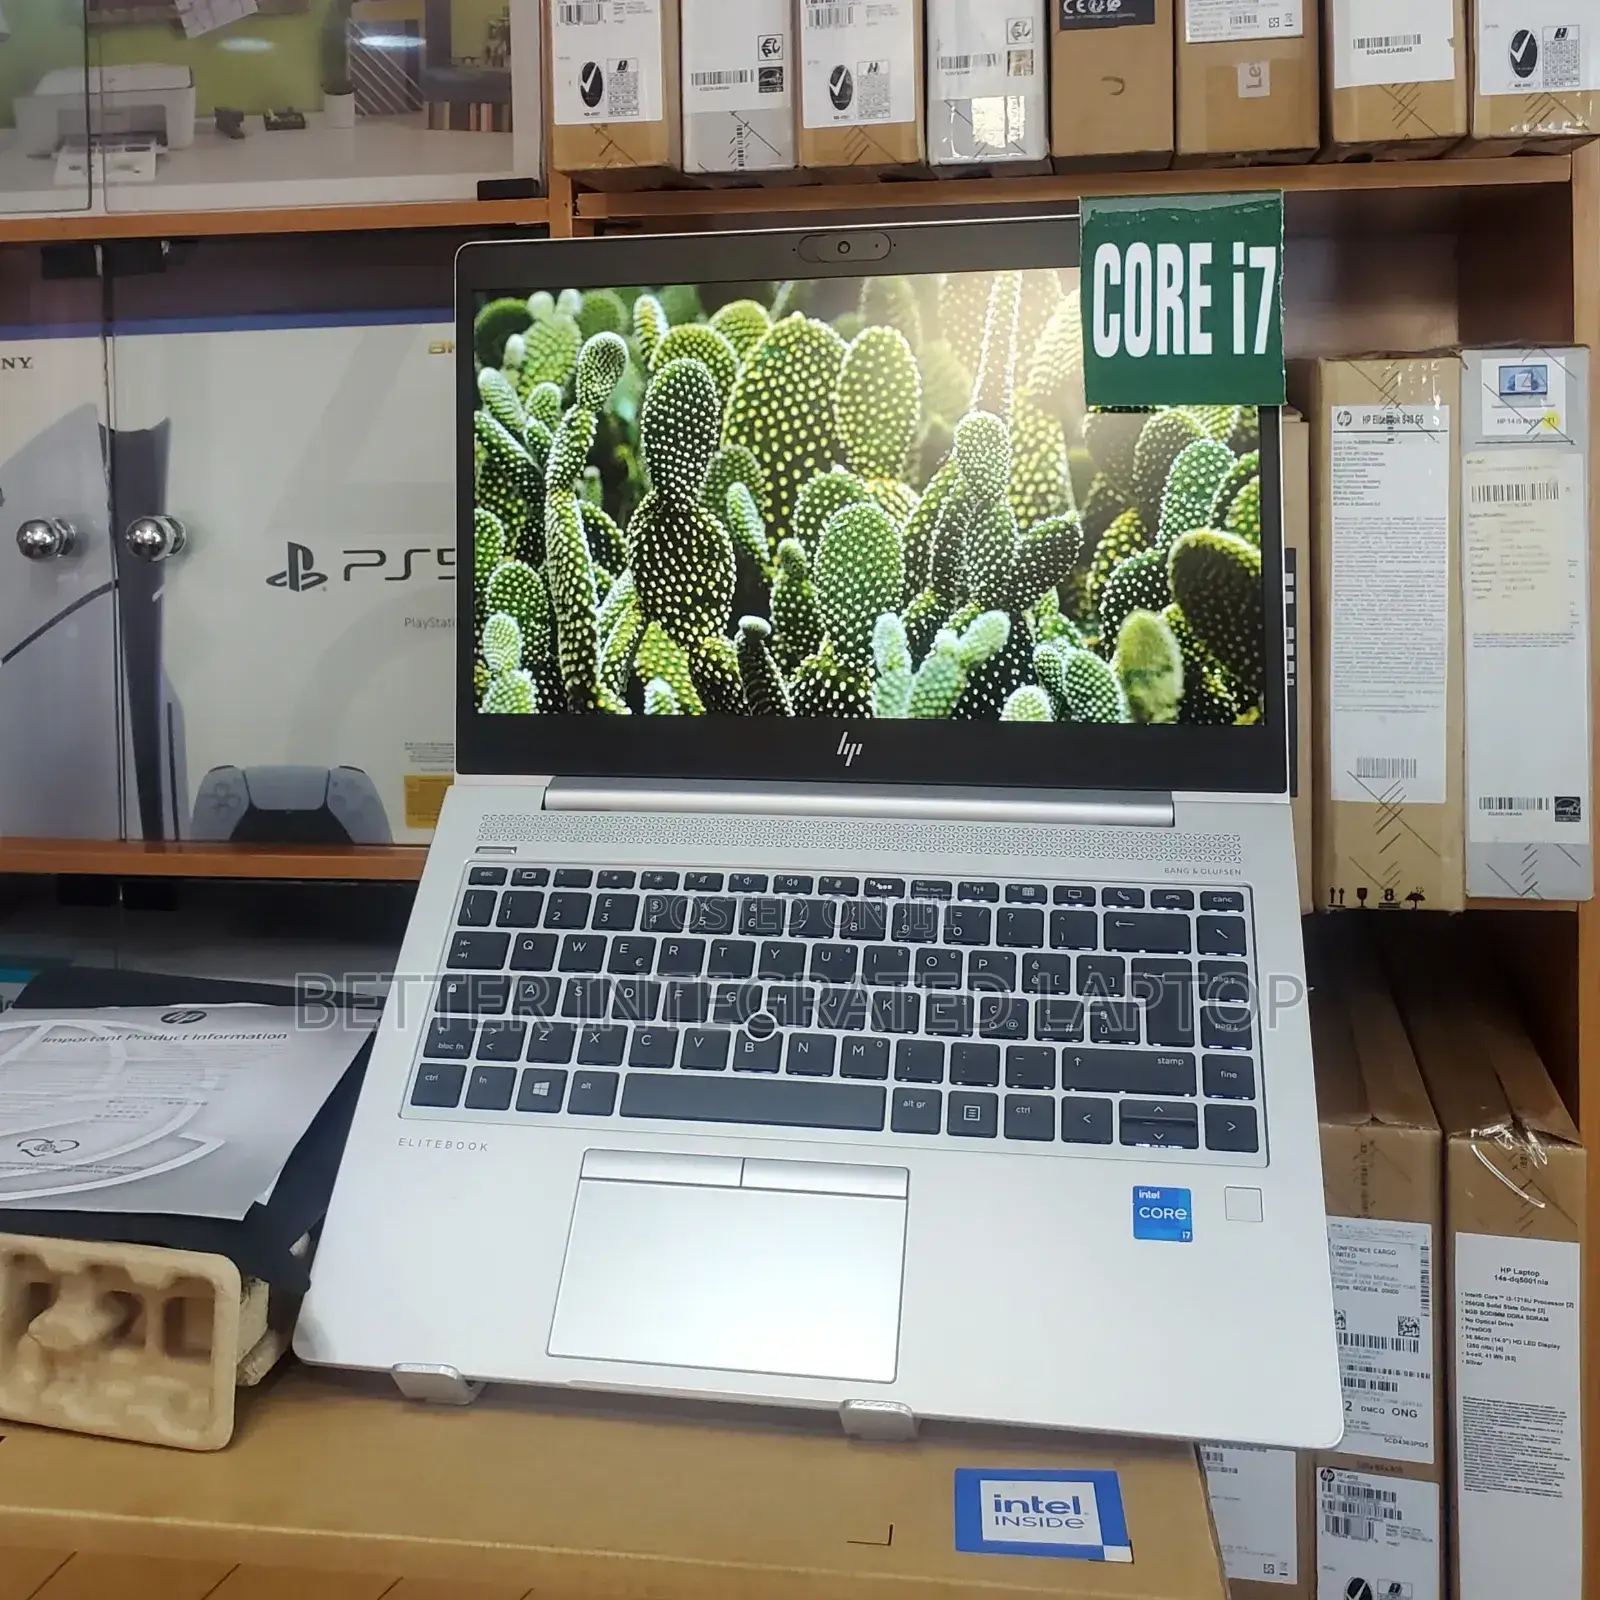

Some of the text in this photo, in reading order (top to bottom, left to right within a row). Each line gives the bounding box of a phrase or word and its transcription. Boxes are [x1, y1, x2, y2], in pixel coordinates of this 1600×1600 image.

[1093, 241, 1277, 358] CORE i7
[1164, 867, 1190, 875] BANG
[1200, 868, 1242, 876] OLUFSEN
[505, 910, 511, 919] 1
[552, 911, 561, 921] 2
[601, 913, 609, 922] 3
[650, 914, 657, 923] 4
[699, 916, 706, 925] 5
[748, 917, 756, 927] 6
[850, 922, 858, 931] 8
[901, 924, 910, 934] 9
[523, 940, 534, 950] Q
[572, 941, 587, 952] W
[619, 943, 629, 954] E
[668, 945, 679, 956] R
[719, 947, 728, 958] T
[770, 949, 780, 959] Y
[821, 951, 831, 962] U
[978, 959, 988, 969] P
[525, 984, 536, 994] A
[574, 986, 583, 997] S
[624, 988, 634, 998] D
[674, 990, 684, 1000] F
[726, 991, 737, 1002] G
[777, 994, 787, 1005] H
[828, 997, 837, 1007] J
[882, 1000, 893, 1011] K
[936, 1003, 945, 1014] L
[42, 1033, 122, 1043] Important
[126, 1032, 188, 1042] Product
[538, 1031, 549, 1041] Z
[590, 1032, 601, 1043] X
[641, 1035, 651, 1045] C
[694, 1037, 704, 1047] V
[744, 1042, 754, 1052] B
[798, 1042, 809, 1053] N
[852, 1045, 864, 1056] M
[1157, 1057, 1184, 1066] stamp
[424, 1074, 439, 1082] ctrl
[1220, 1070, 1238, 1079] fine
[478, 1076, 487, 1084] fn
[581, 1082, 592, 1090] alt
[916, 1101, 926, 1109] gr
[1015, 1106, 1031, 1114] ctrl
[398, 1137, 489, 1152] ELITEBOOK
[1138, 1189, 1160, 1199] intel
[1182, 1231, 1191, 1239] i7
[1500, 1266, 1540, 1278] HP Laptop
[1503, 1303, 1518, 1311] State
[1534, 1298, 1565, 1307] Processor
[1475, 1318, 1497, 1326] Optical
[1465, 1325, 1492, 1333] FreeDOS
[1537, 1342, 1560, 1350] Display
[1391, 1407, 1418, 1418] ONG
[993, 1494, 1083, 1515] intel
